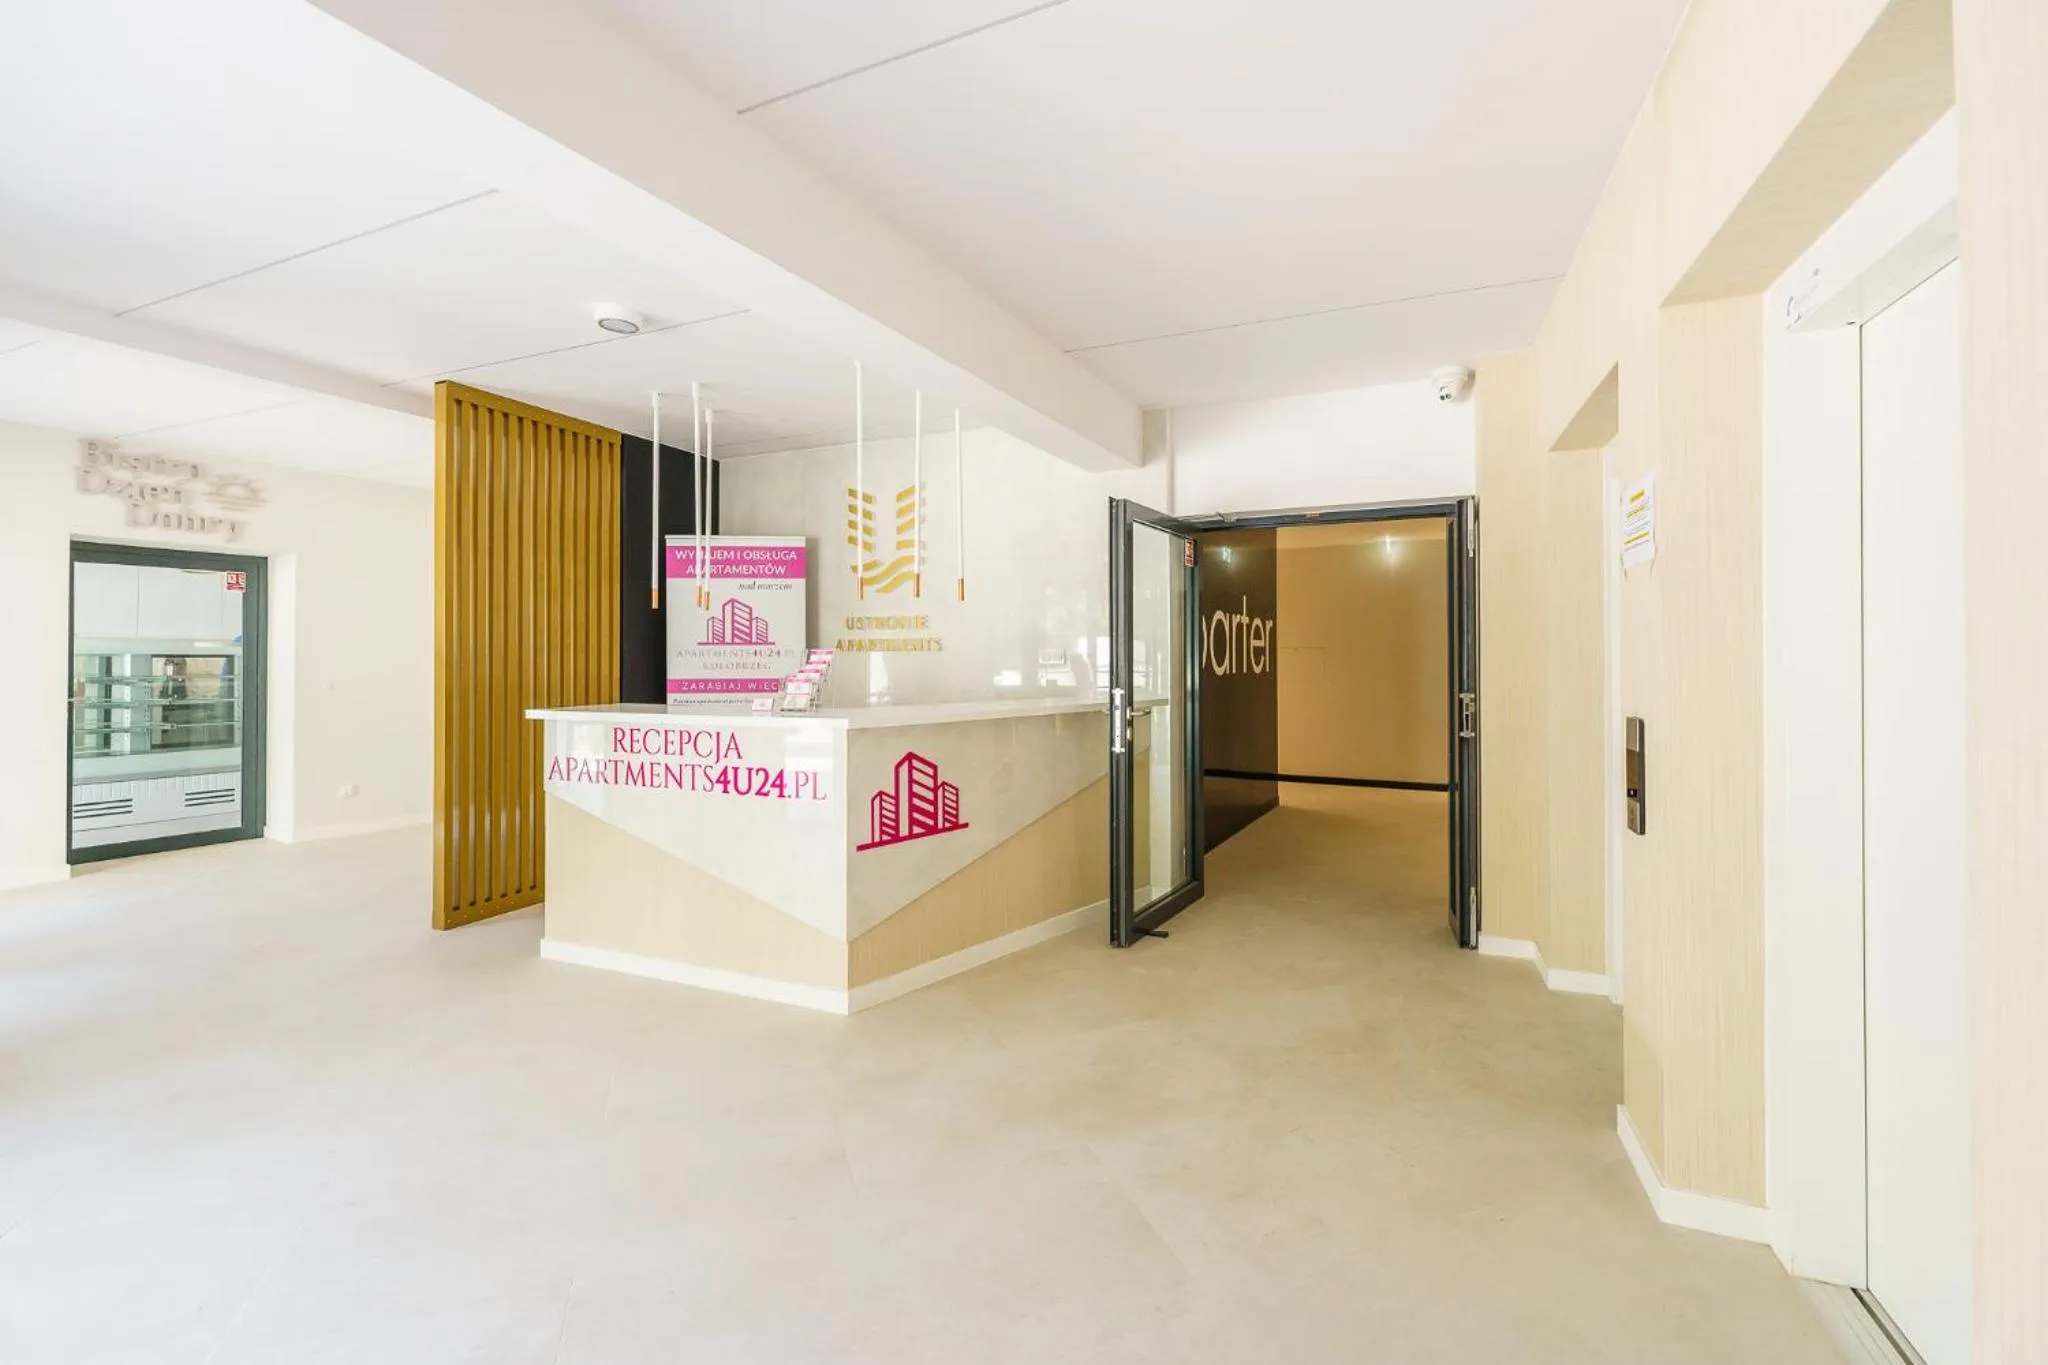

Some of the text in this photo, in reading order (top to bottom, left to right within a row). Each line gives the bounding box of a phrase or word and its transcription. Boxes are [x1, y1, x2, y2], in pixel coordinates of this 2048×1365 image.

[675, 549, 734, 560] WYJEM
[743, 549, 797, 561] OBSŁUGA
[1202, 594, 1274, 677] arter
[681, 681, 742, 691] ZARABIAJ
[612, 726, 744, 765] RECEPCJA
[548, 755, 828, 802] APARTMENTS4U24.PL
